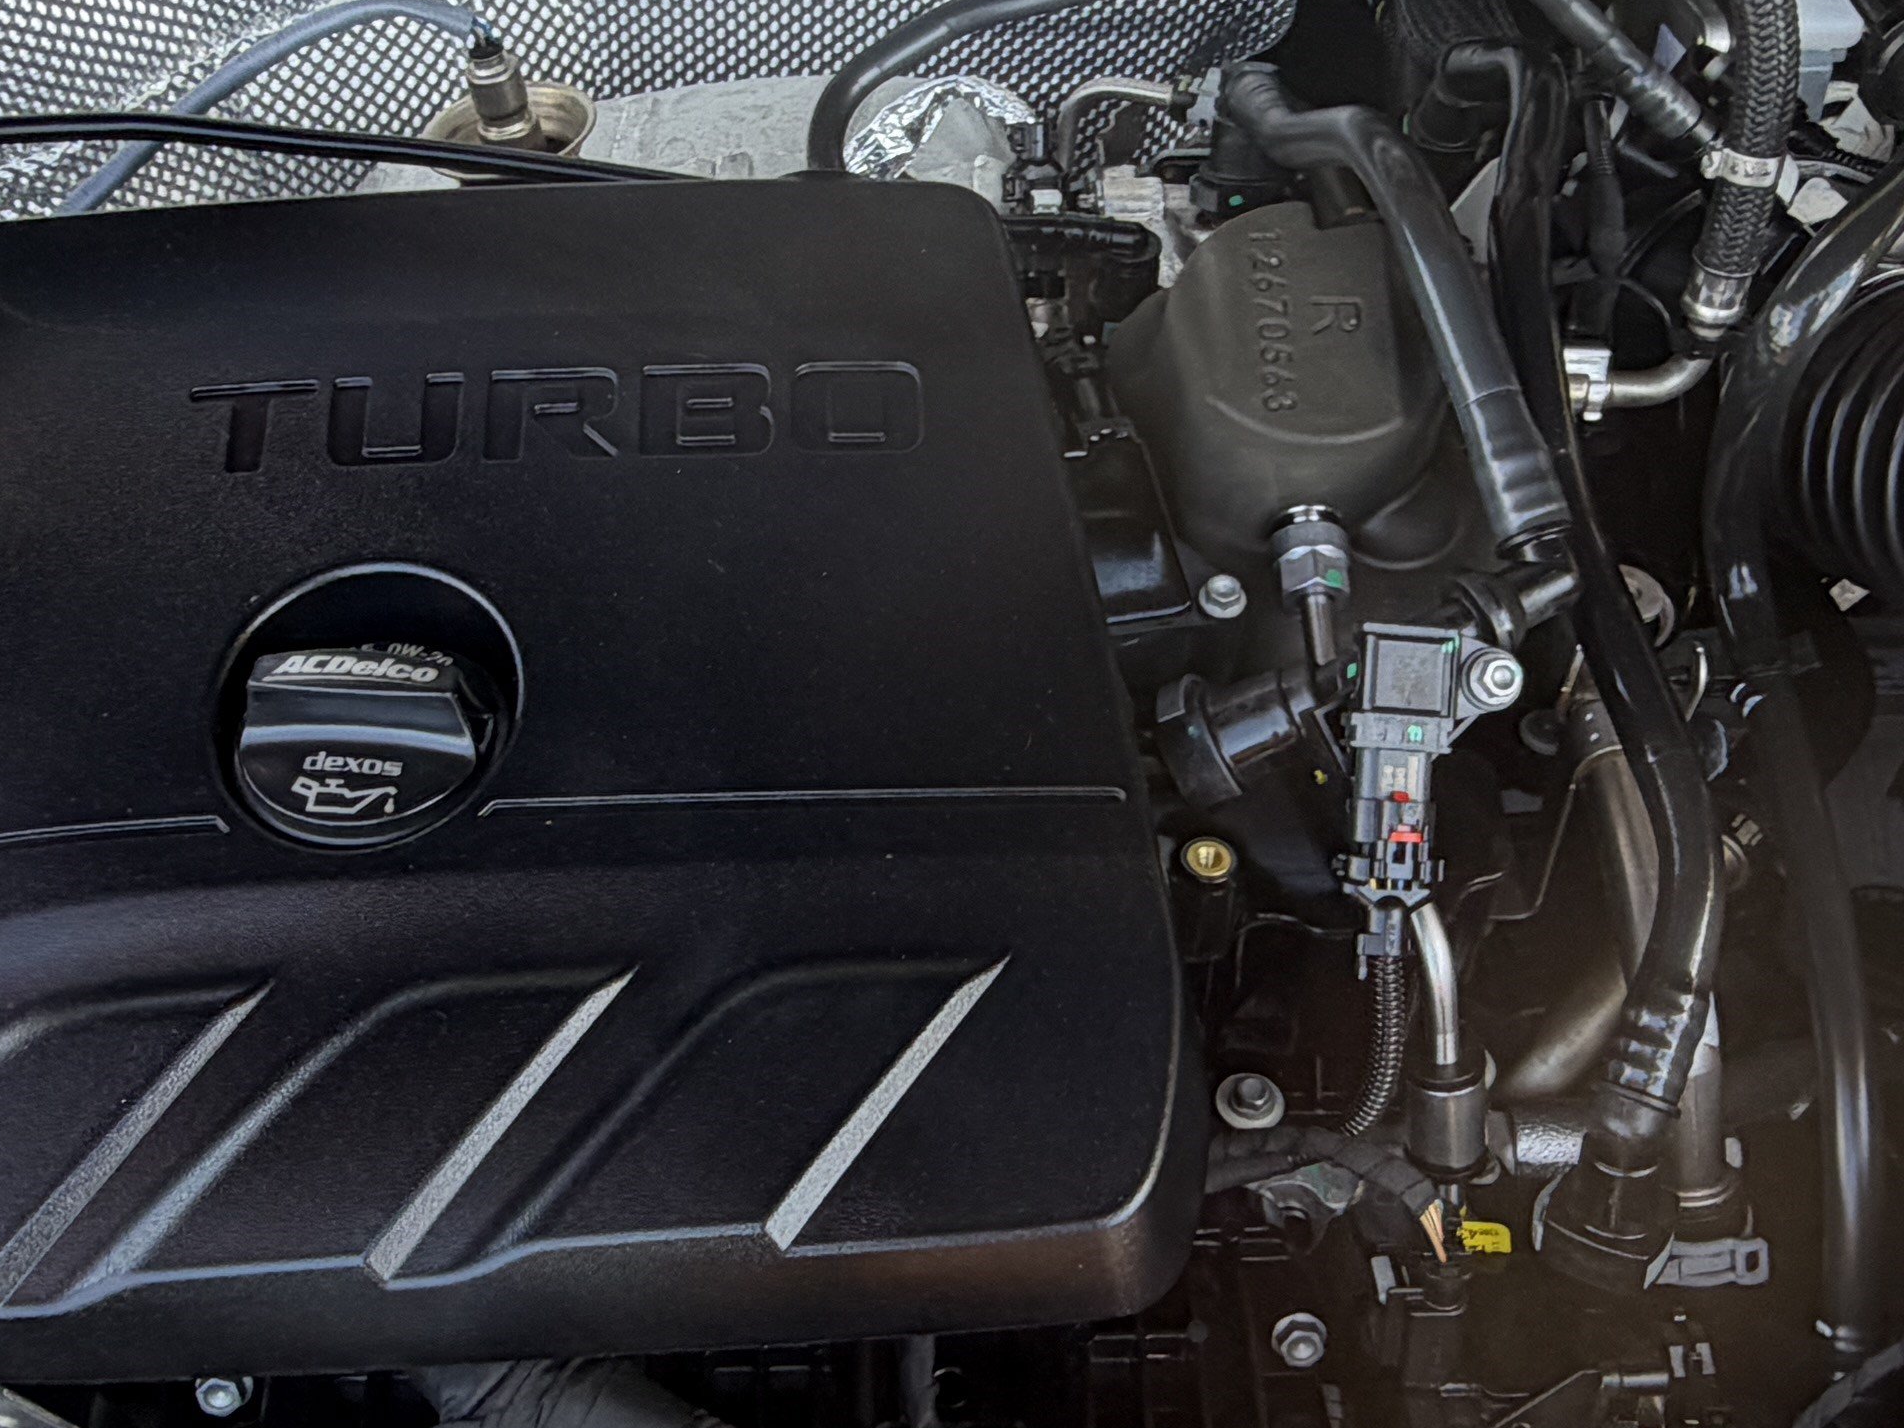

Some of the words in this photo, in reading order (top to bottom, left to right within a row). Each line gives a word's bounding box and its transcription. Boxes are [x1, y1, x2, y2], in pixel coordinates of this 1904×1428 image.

[1247, 227, 1299, 413] 12670563
[1310, 295, 1363, 335] R
[189, 360, 925, 474] TURBO
[271, 655, 439, 683] ACDelco
[302, 751, 404, 776] dexos
